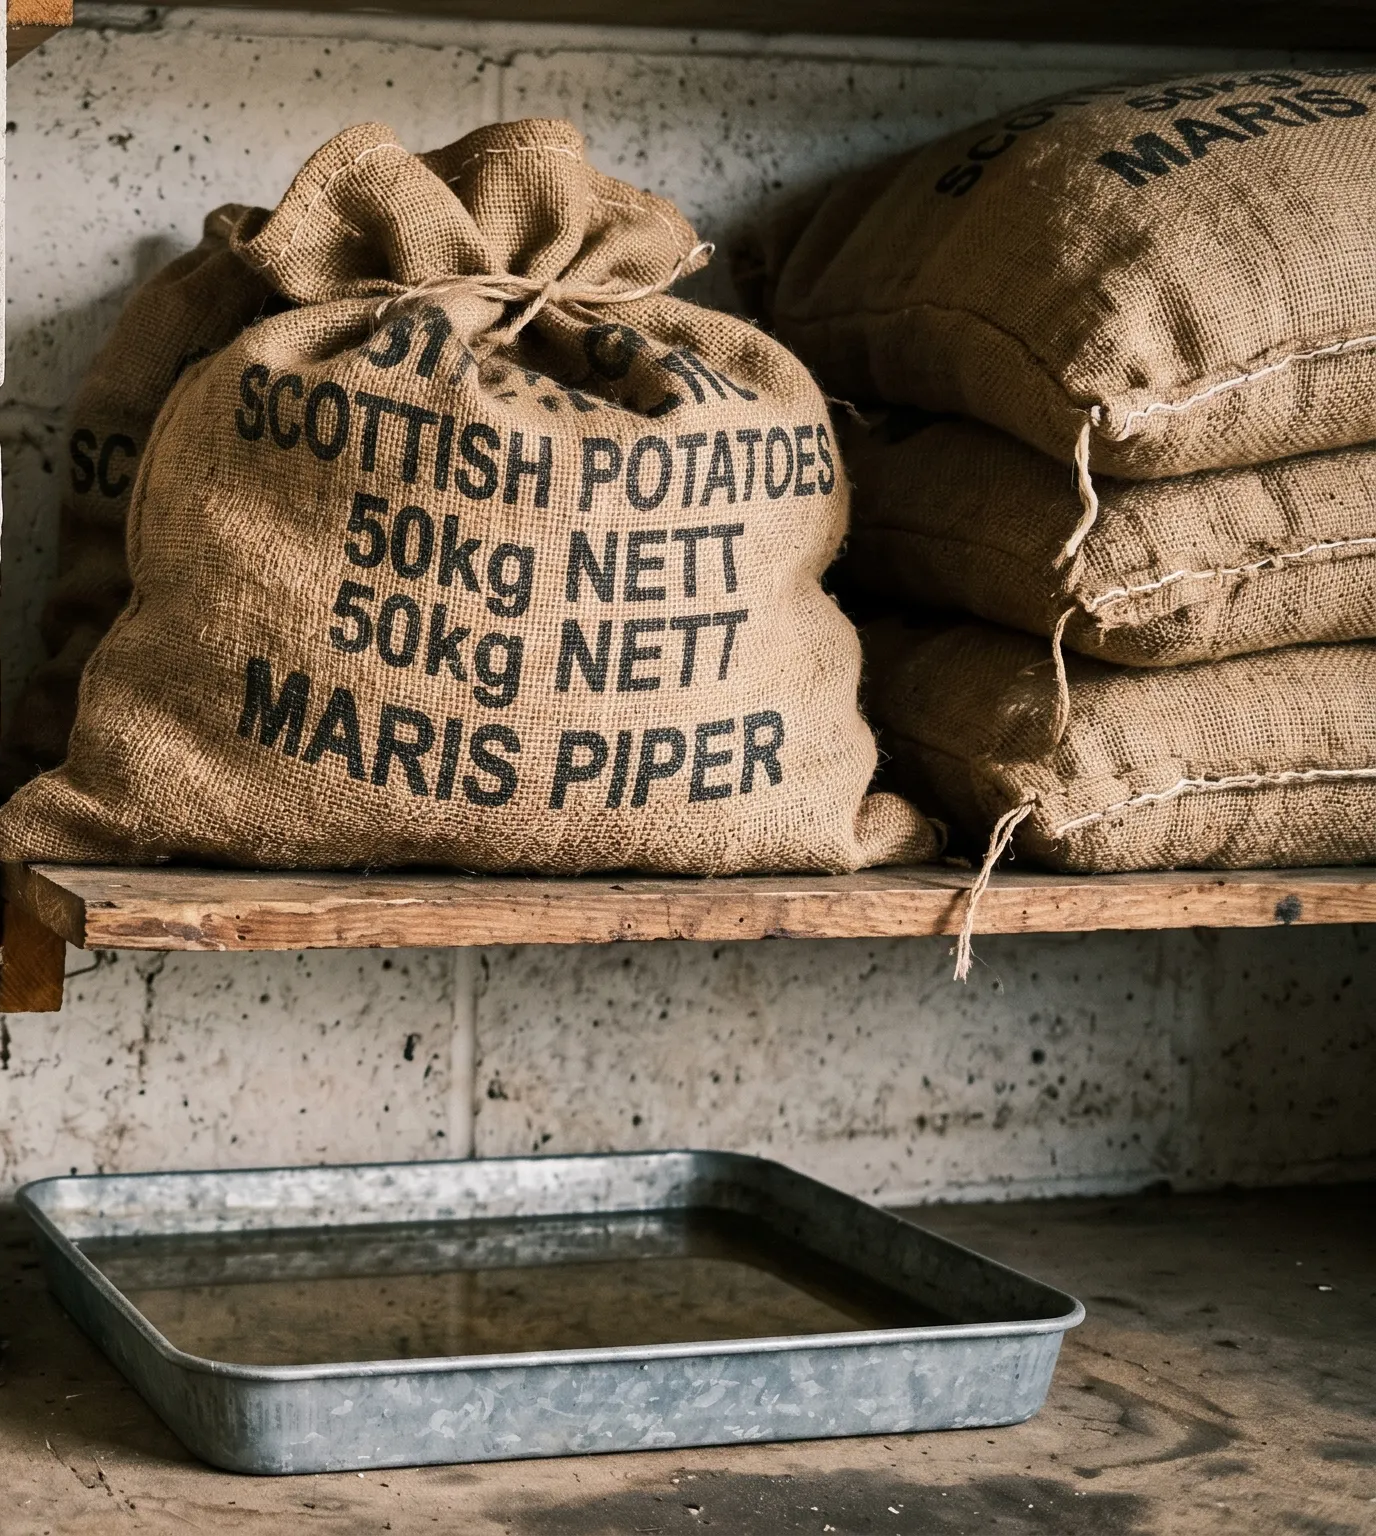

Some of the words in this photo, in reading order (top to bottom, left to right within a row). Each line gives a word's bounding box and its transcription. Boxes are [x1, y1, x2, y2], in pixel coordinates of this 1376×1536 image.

[1095, 89, 1369, 188] MARIS
[235, 363, 552, 508] SCOTTISH
[578, 422, 836, 512] POTATOES
[343, 492, 536, 618] 50kg
[564, 523, 745, 604] NETT
[328, 580, 525, 708] 50kg
[554, 609, 749, 693] NETT
[236, 656, 522, 807] MARIS
[548, 710, 785, 809] PIPER
